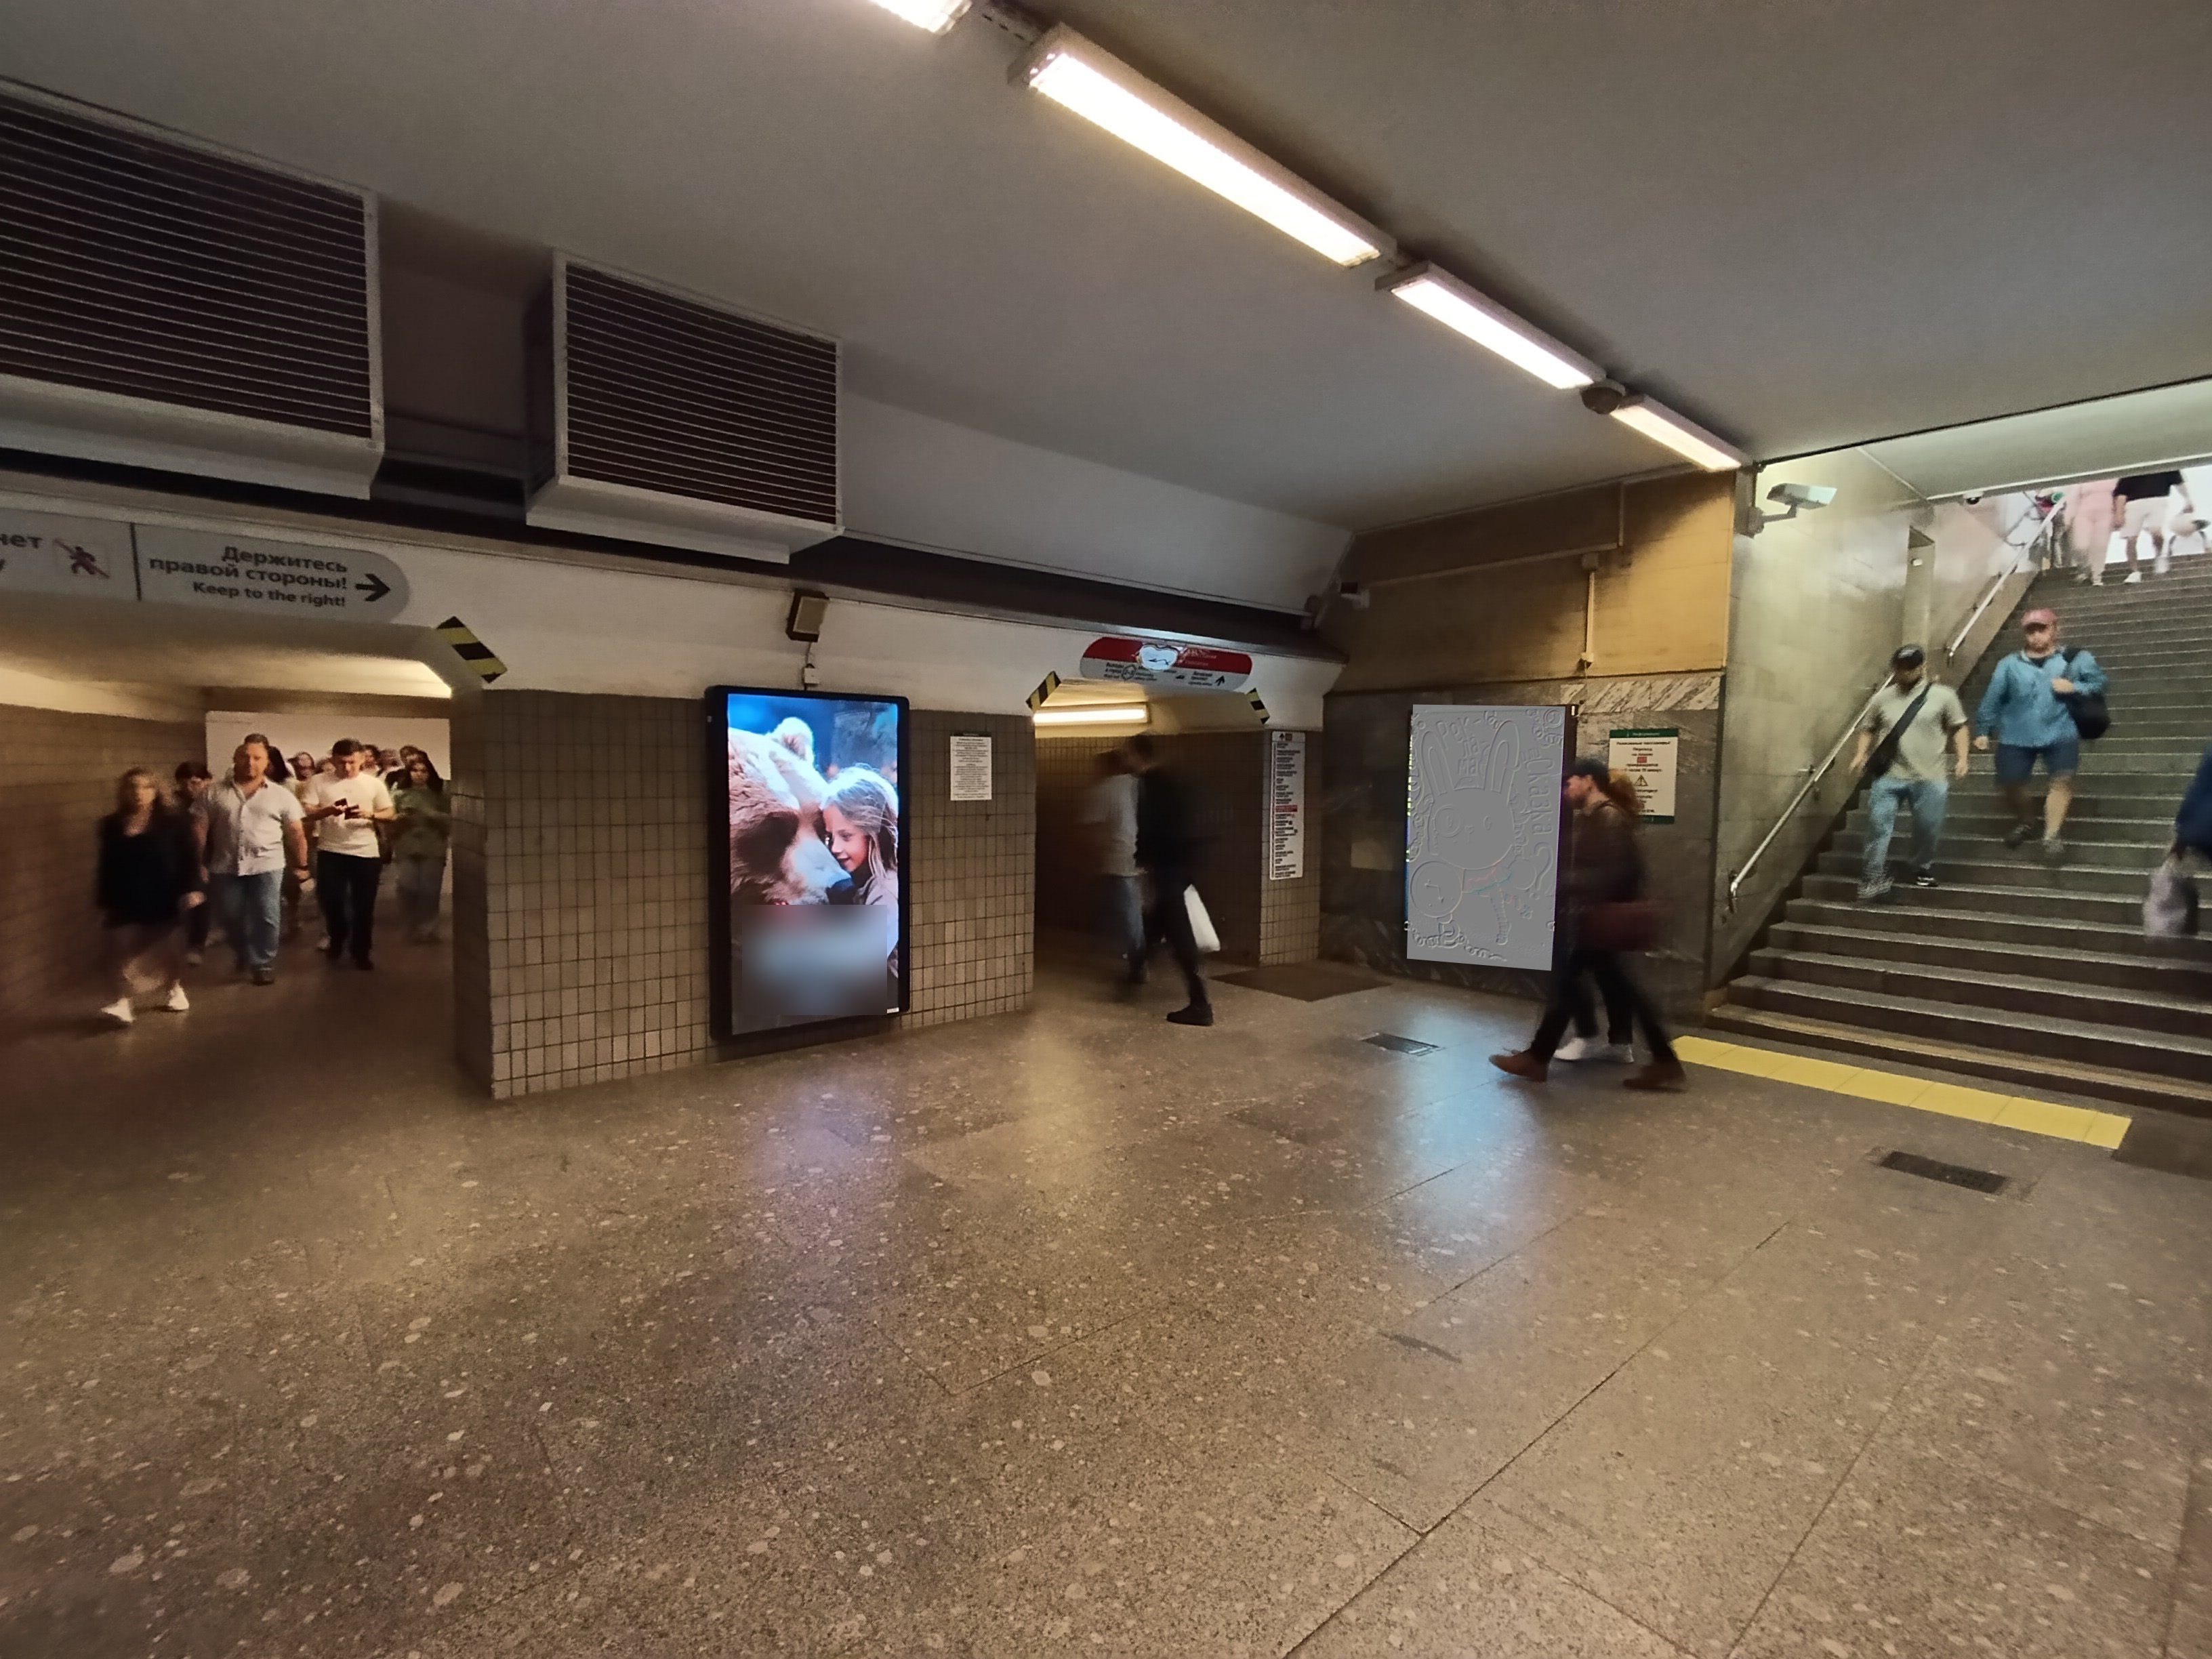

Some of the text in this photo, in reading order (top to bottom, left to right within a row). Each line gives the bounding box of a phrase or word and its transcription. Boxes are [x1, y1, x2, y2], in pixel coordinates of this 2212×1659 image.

[222, 546, 348, 573] Держитесь
[149, 558, 347, 589] правой стороны!
[193, 581, 346, 607] Keep to the right!
